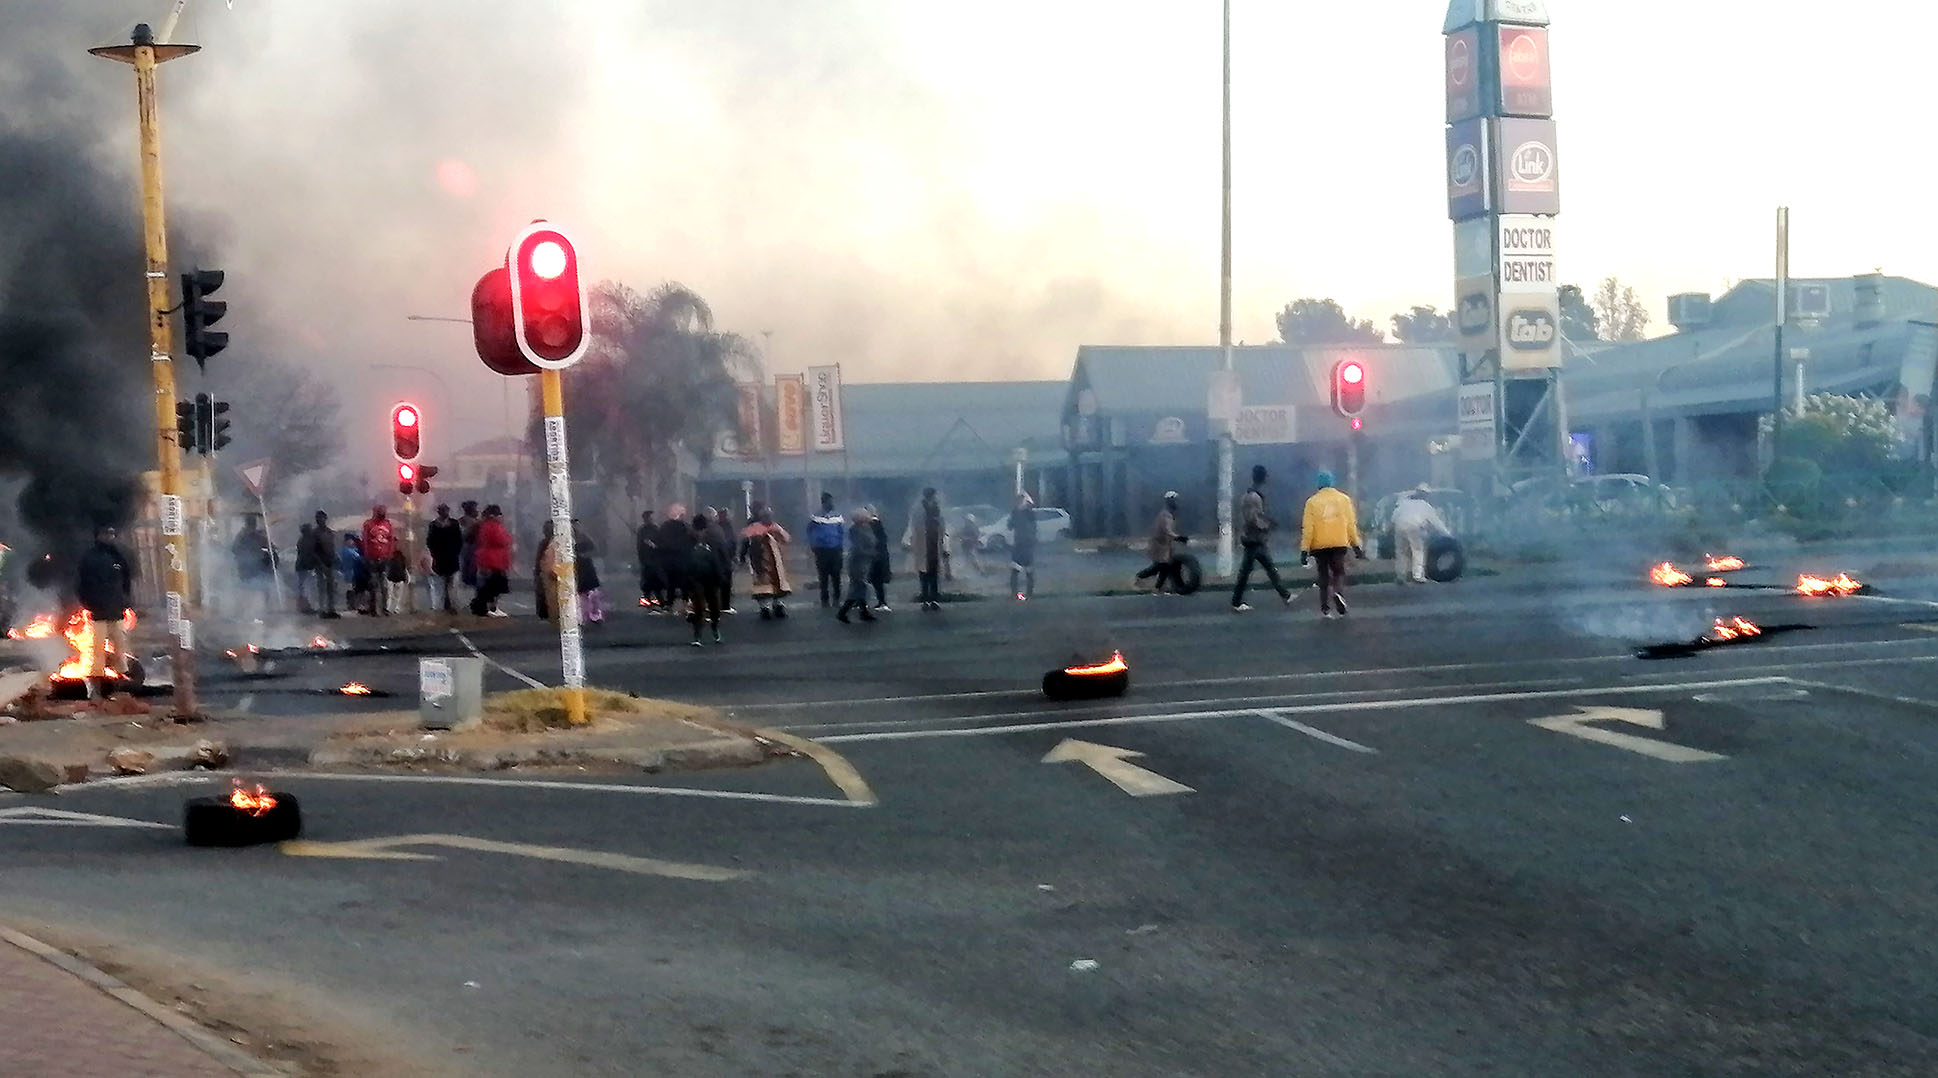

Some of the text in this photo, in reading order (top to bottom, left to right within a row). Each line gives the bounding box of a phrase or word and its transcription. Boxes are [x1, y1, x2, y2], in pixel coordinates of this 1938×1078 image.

[1518, 150, 1545, 175] Link
[1503, 227, 1552, 249] DOCTOR
[1503, 261, 1553, 282] DENTIST
